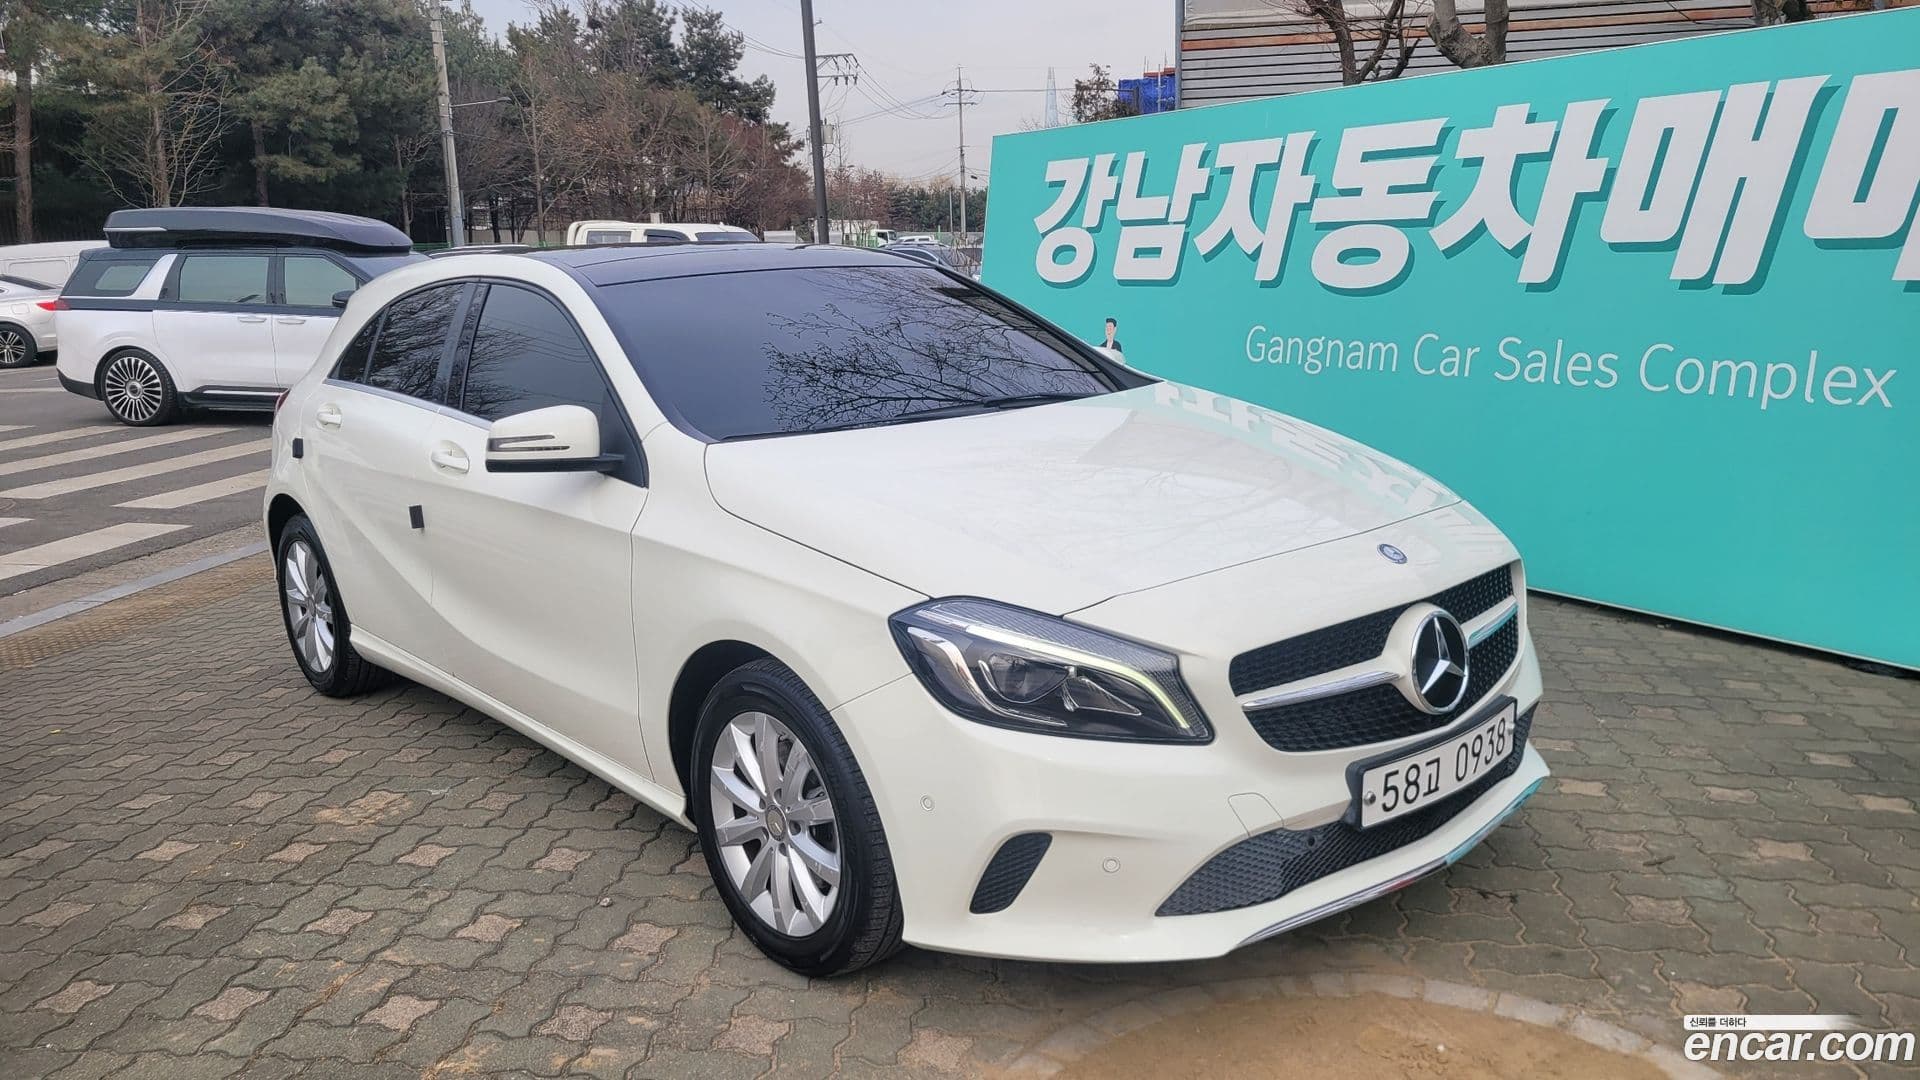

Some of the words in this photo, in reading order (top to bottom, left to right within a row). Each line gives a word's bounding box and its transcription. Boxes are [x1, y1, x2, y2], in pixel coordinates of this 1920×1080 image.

[1246, 325, 1399, 375] Gangnam
[1413, 333, 1481, 377] Car
[1494, 336, 1619, 389] Sales
[1639, 343, 1897, 410] Complex
[1381, 757, 1441, 813] 58고
[1456, 717, 1506, 782] 0938
